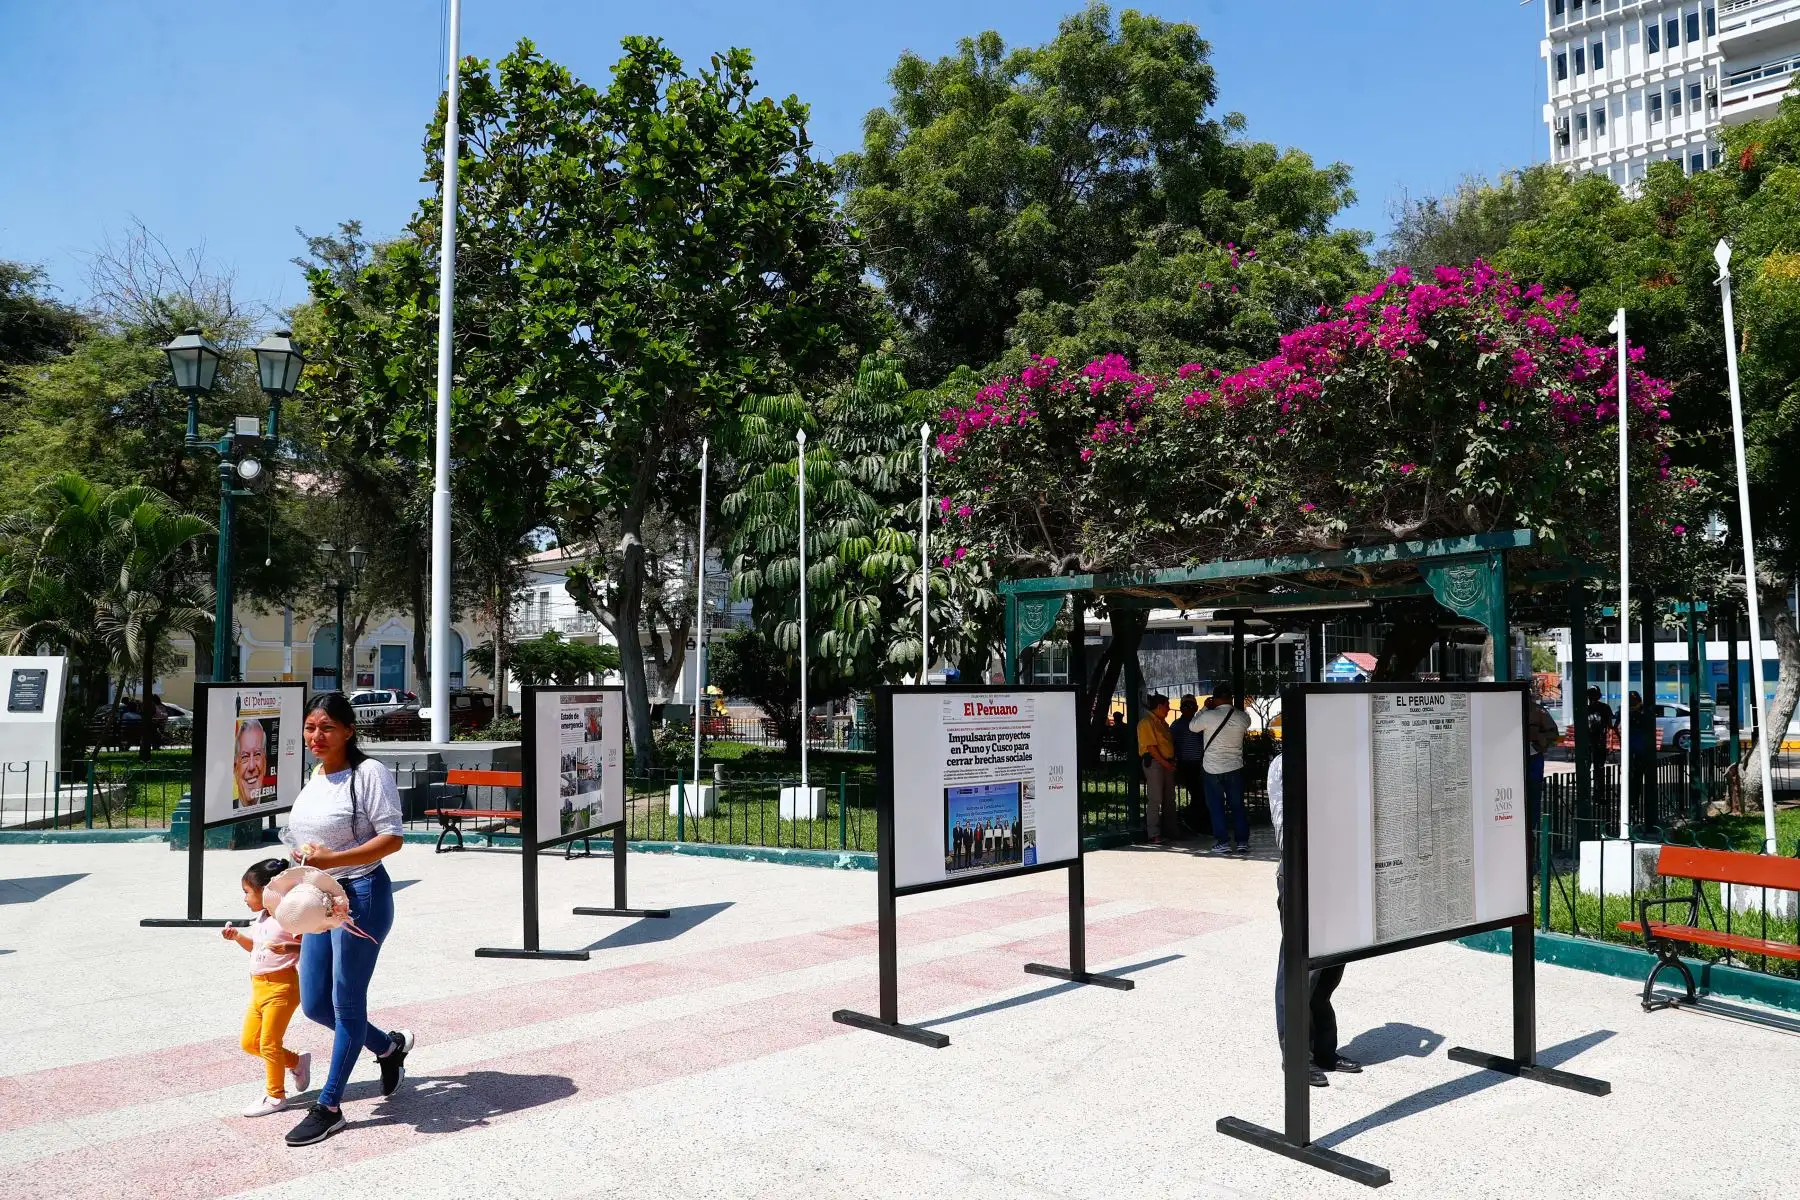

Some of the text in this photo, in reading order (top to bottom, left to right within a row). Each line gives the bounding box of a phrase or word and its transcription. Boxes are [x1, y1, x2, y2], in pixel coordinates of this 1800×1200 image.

[1294, 642, 1305, 673] TOURS
[1396, 696, 1407, 706] EL
[1408, 694, 1445, 706] PERUANO
[964, 703, 975, 716] El
[976, 702, 1018, 716] Peruano
[560, 721, 584, 730] emergencia
[948, 731, 1031, 744] Impulsarán proyectos
[950, 742, 1030, 755] en Puno y Cusco para
[946, 752, 1033, 767] cerrar brechas sociales
[270, 766, 277, 776] EL
[1048, 765, 1064, 776] 200
[250, 785, 277, 799] CELEBRA
[1494, 787, 1513, 802] 200
